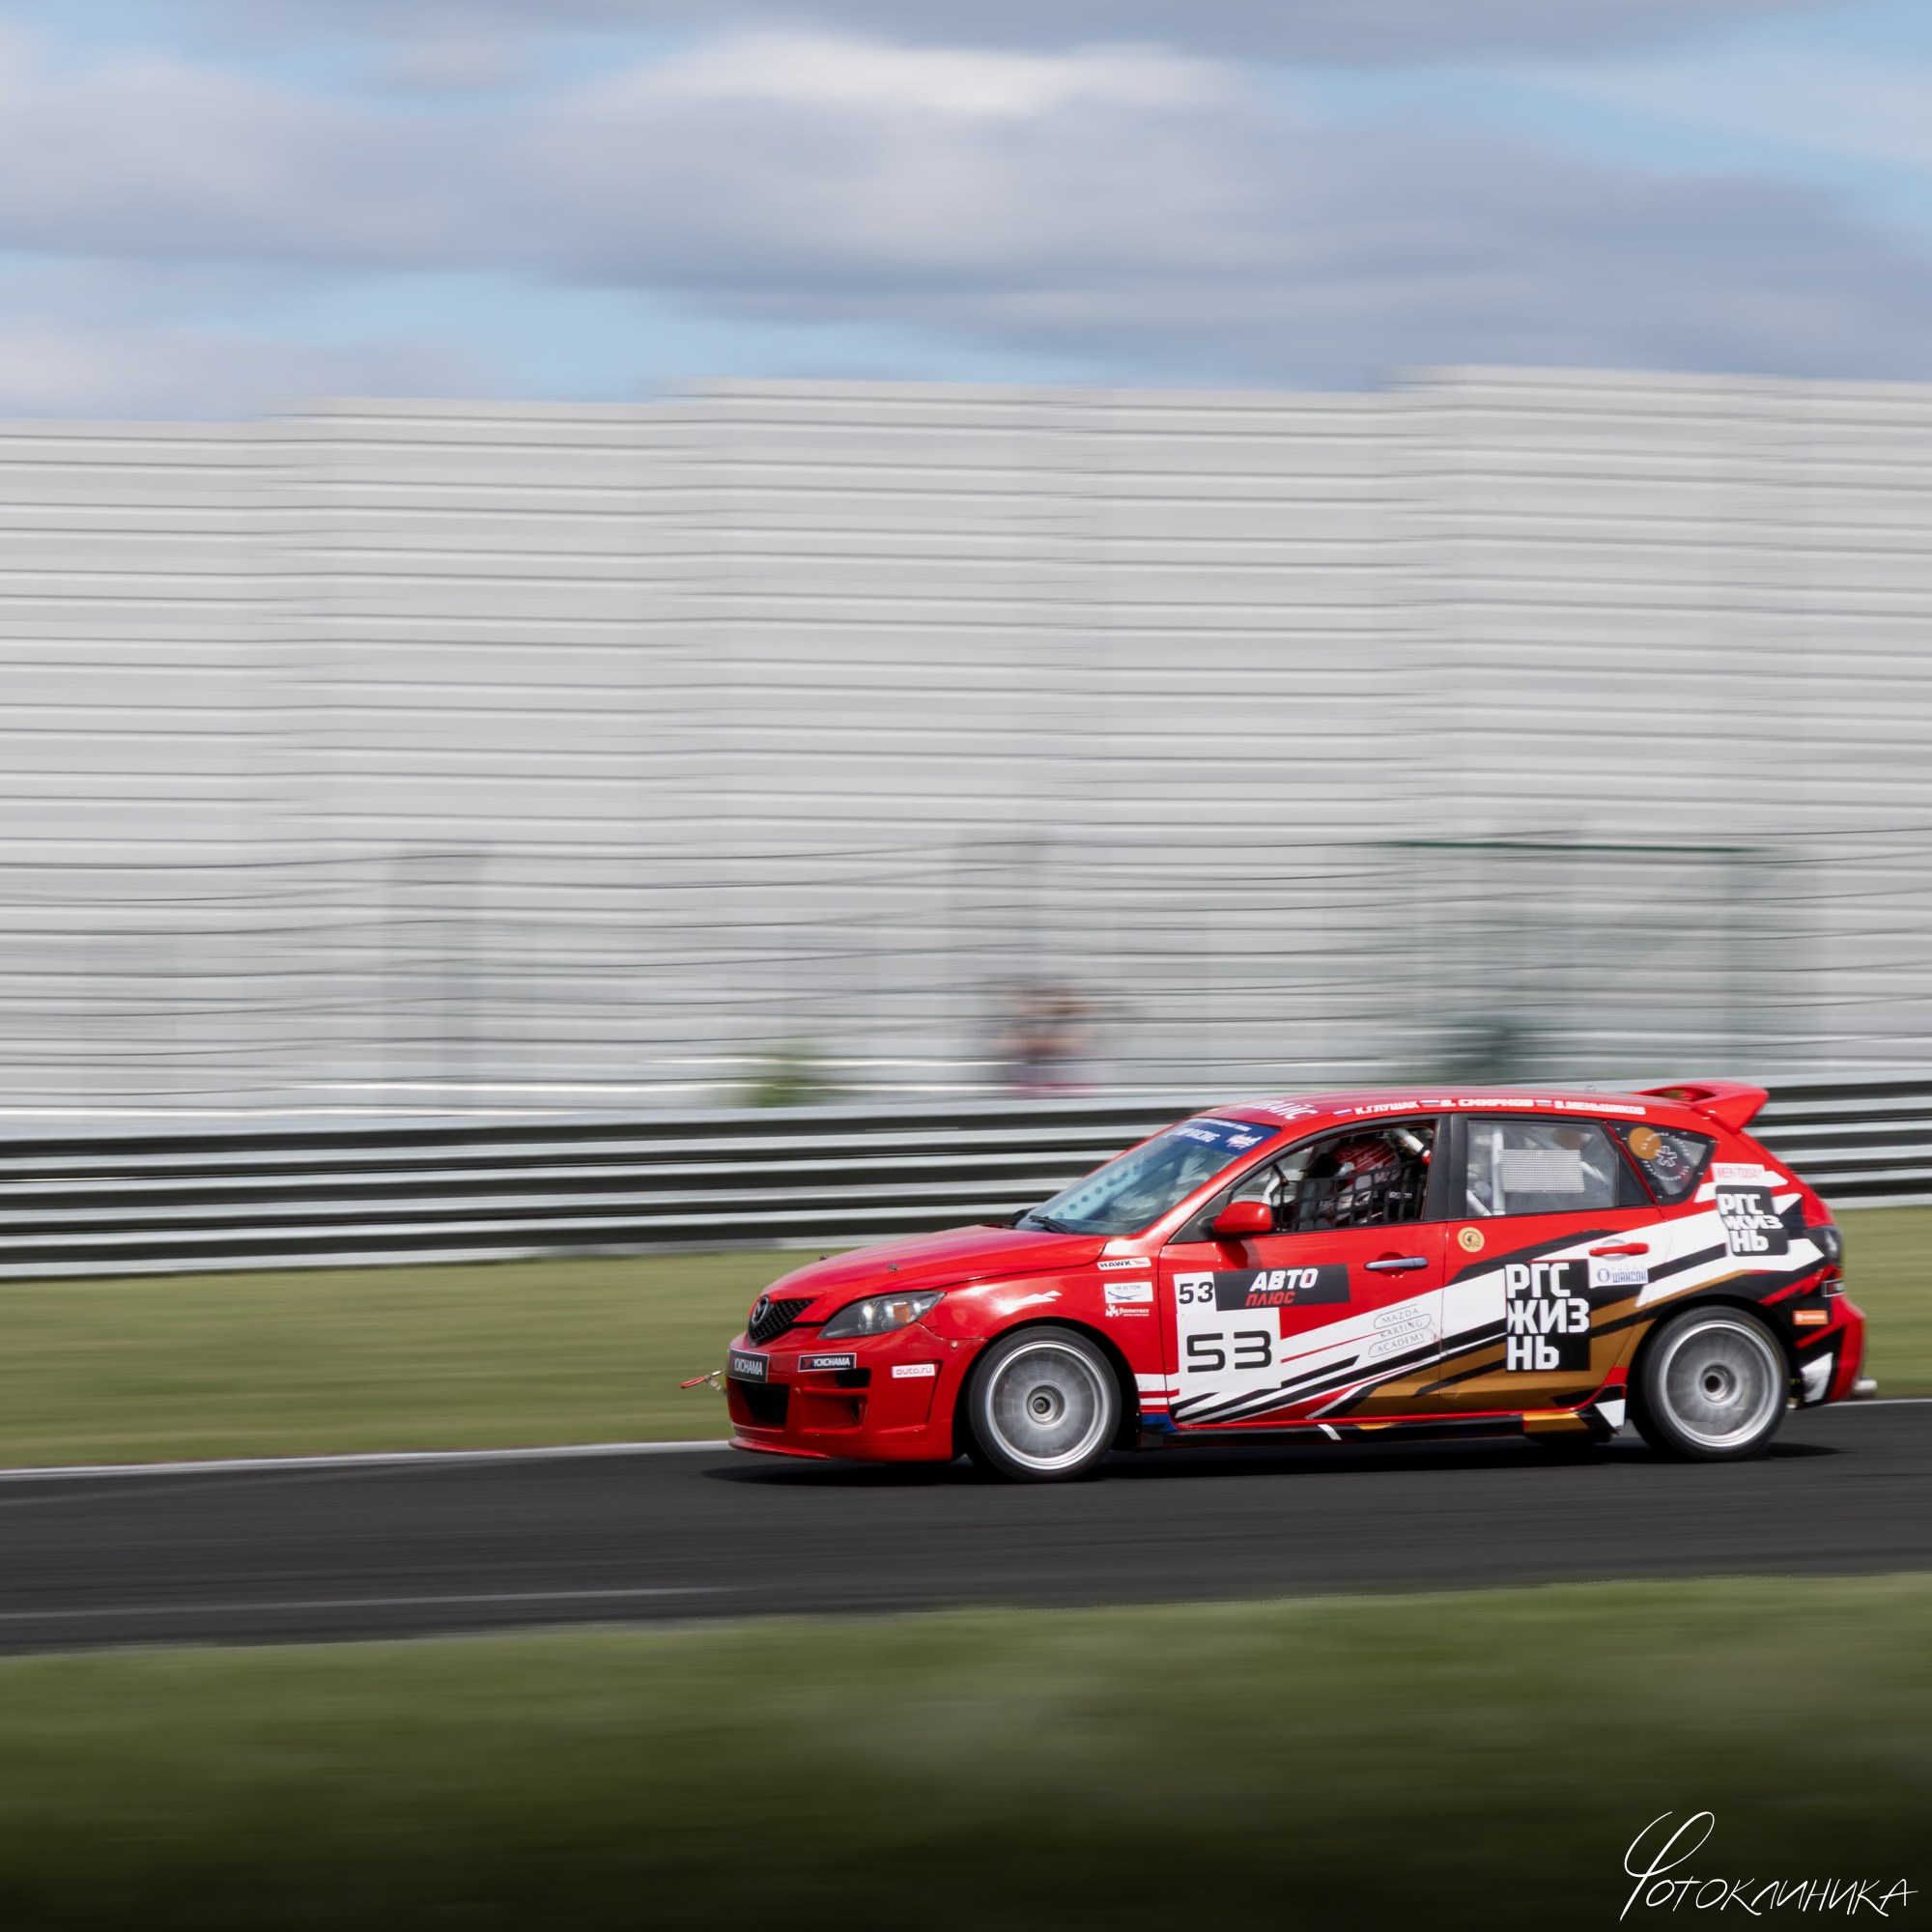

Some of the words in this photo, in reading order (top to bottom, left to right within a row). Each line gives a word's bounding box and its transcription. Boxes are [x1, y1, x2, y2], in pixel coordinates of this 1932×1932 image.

[1717, 1193, 1764, 1215] РГС
[1721, 1214, 1784, 1230] ЖИЗ
[1730, 1230, 1769, 1252] НЬ
[1249, 1268, 1319, 1292] АВТО
[1505, 1263, 1572, 1298] РГС
[1179, 1282, 1214, 1304] 53
[1245, 1292, 1296, 1306] ПЛЮС
[1381, 1308, 1420, 1324] MAZDA
[1507, 1298, 1590, 1334] ЖИЗ
[1379, 1320, 1423, 1339] KARTING
[1186, 1330, 1271, 1373] 53
[1377, 1333, 1425, 1352] ACADEMY
[812, 1356, 851, 1368] YOKOHAMA
[1507, 1335, 1560, 1371] НЬ
[733, 1357, 763, 1376] YOKOHAMA
[895, 1366, 932, 1376] auto.ru
